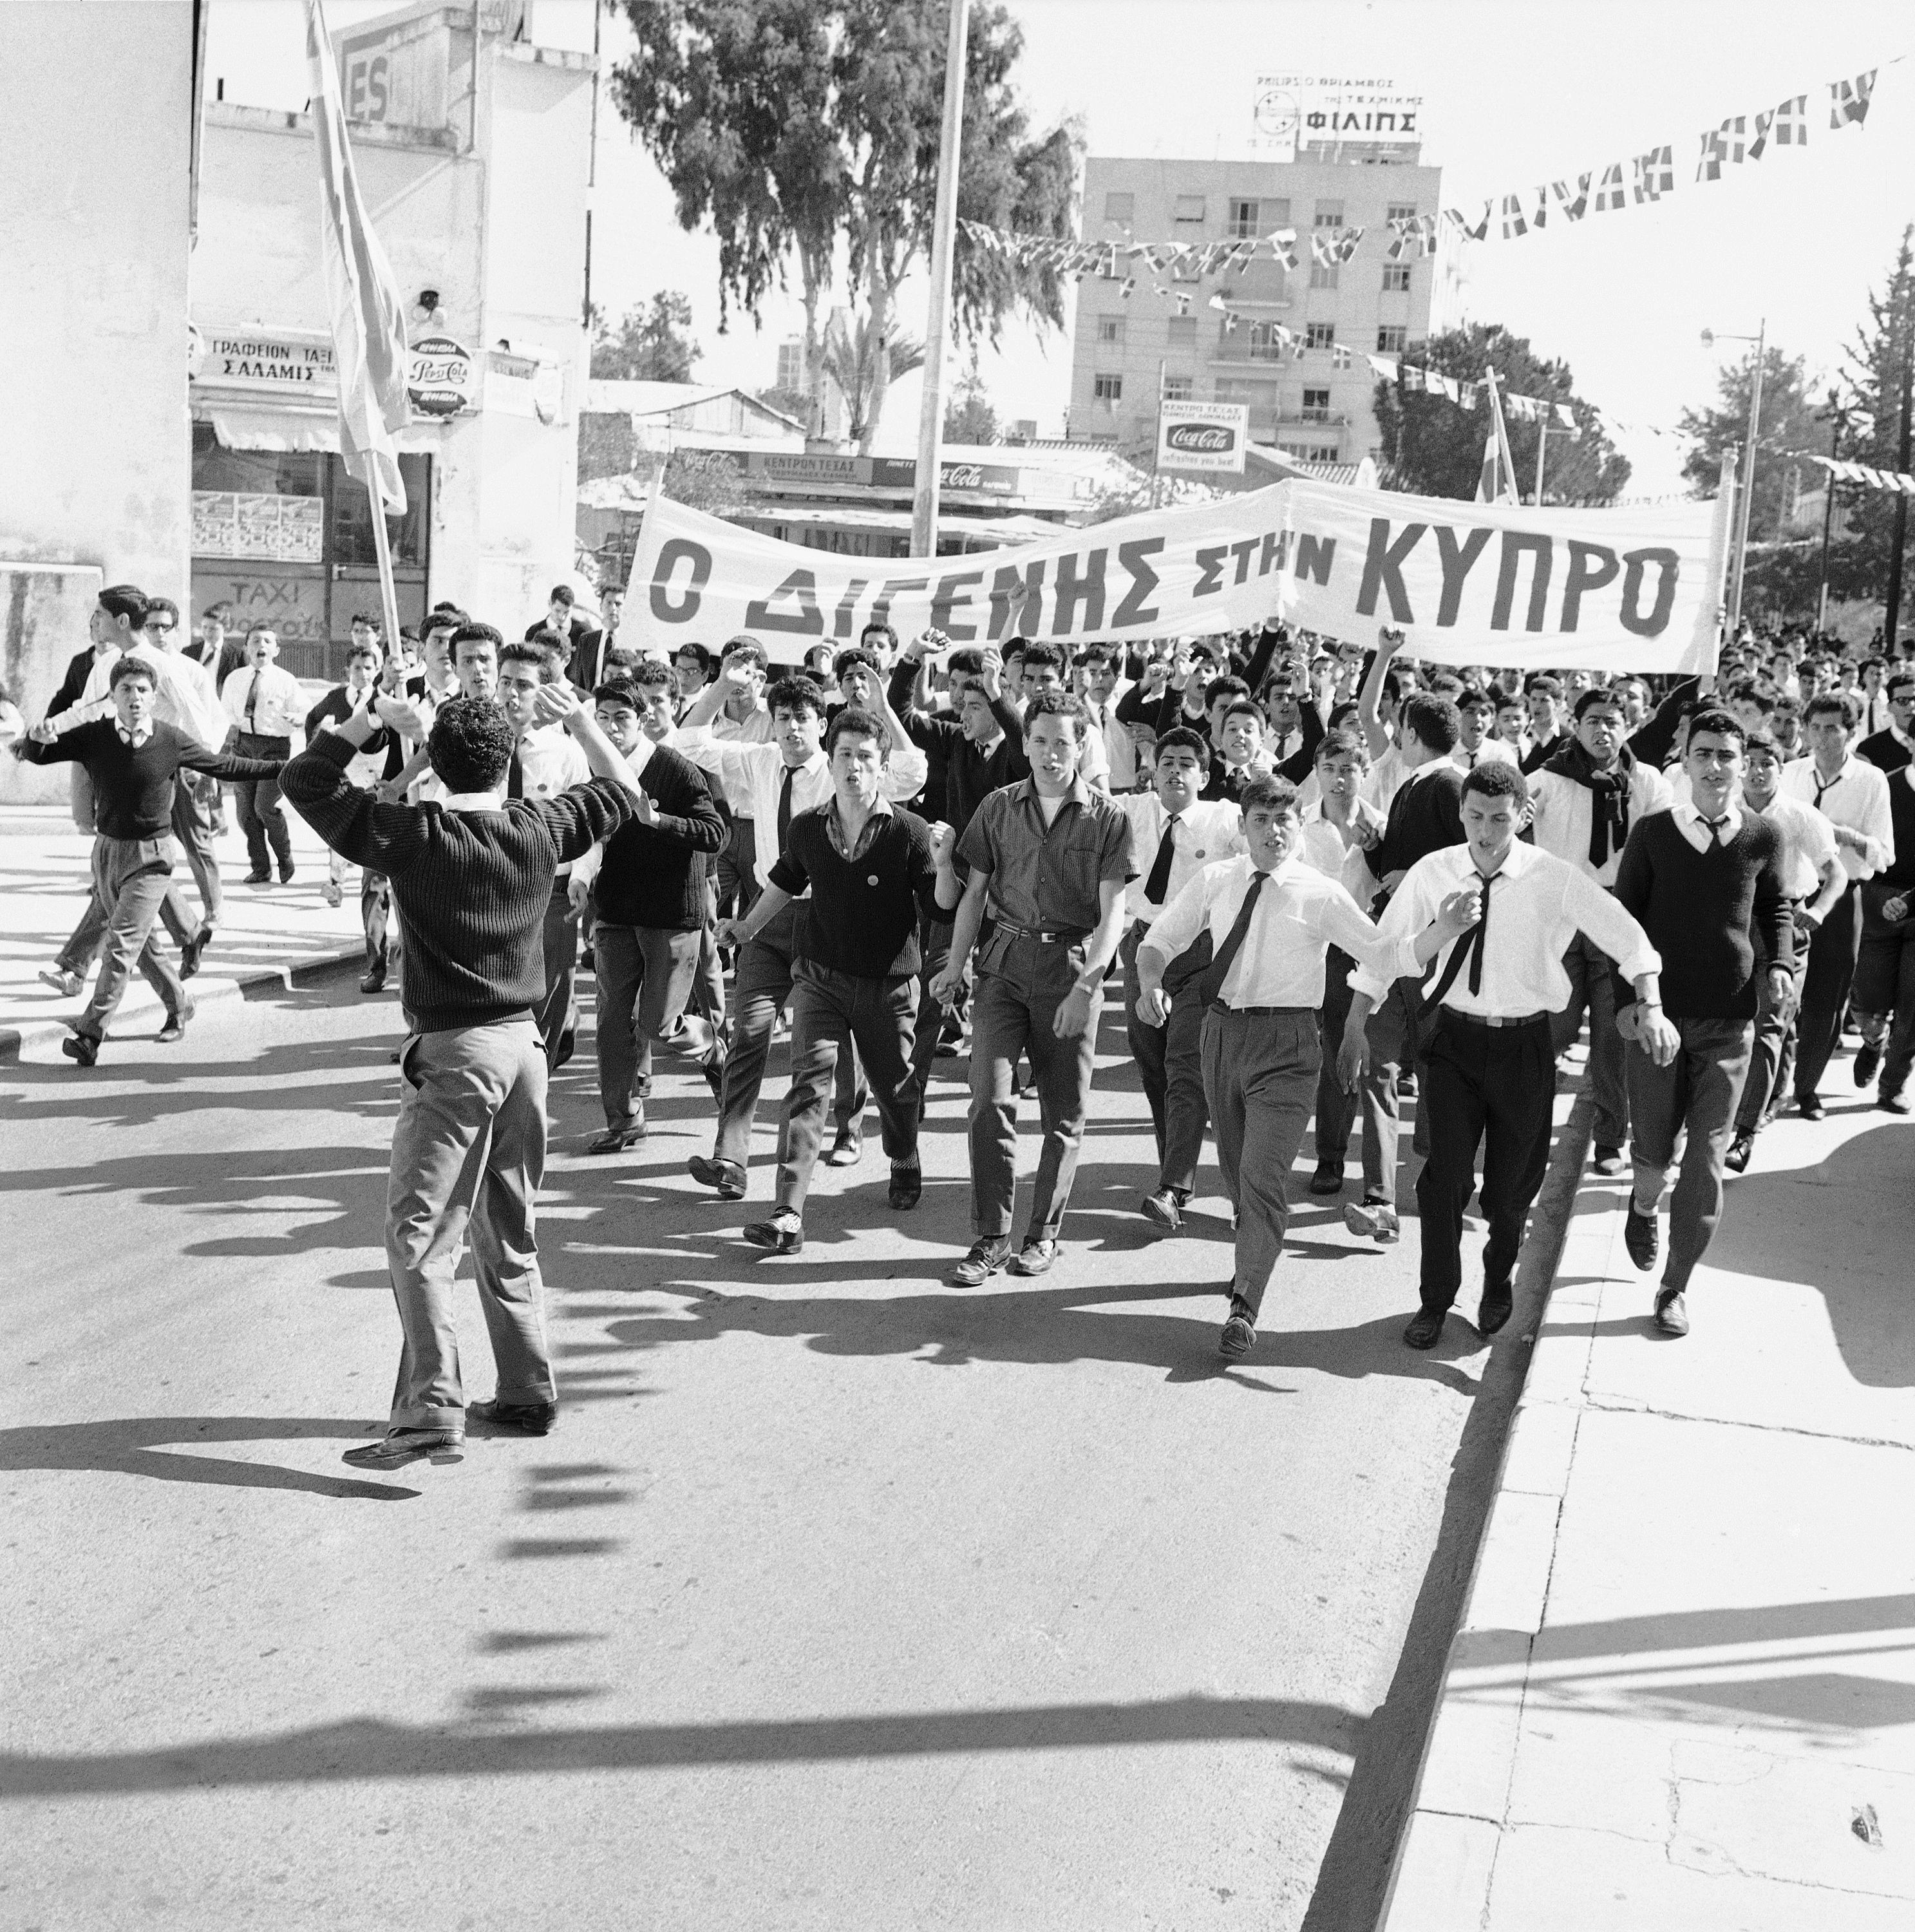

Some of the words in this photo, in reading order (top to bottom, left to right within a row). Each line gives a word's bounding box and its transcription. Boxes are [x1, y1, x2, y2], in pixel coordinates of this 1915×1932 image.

[1307, 111, 1415, 132] ΦΙΛΙΠΣ
[212, 339, 290, 359] ΓΡΑΦΕΙΟΝ
[303, 348, 332, 363] ΤΑΞΙ
[223, 360, 316, 380] ΣΑΛΑΜΙΣ
[764, 457, 816, 470] ΚΕΝΤΡΟΝ
[649, 538, 712, 623] Ο
[744, 536, 1165, 641] ΔΙΓΕΝΗΣ
[1193, 530, 1336, 598] ΣΤΗΝ
[1356, 517, 1679, 638] ΚΥΠΡΟ
[230, 582, 299, 605] TAXI
